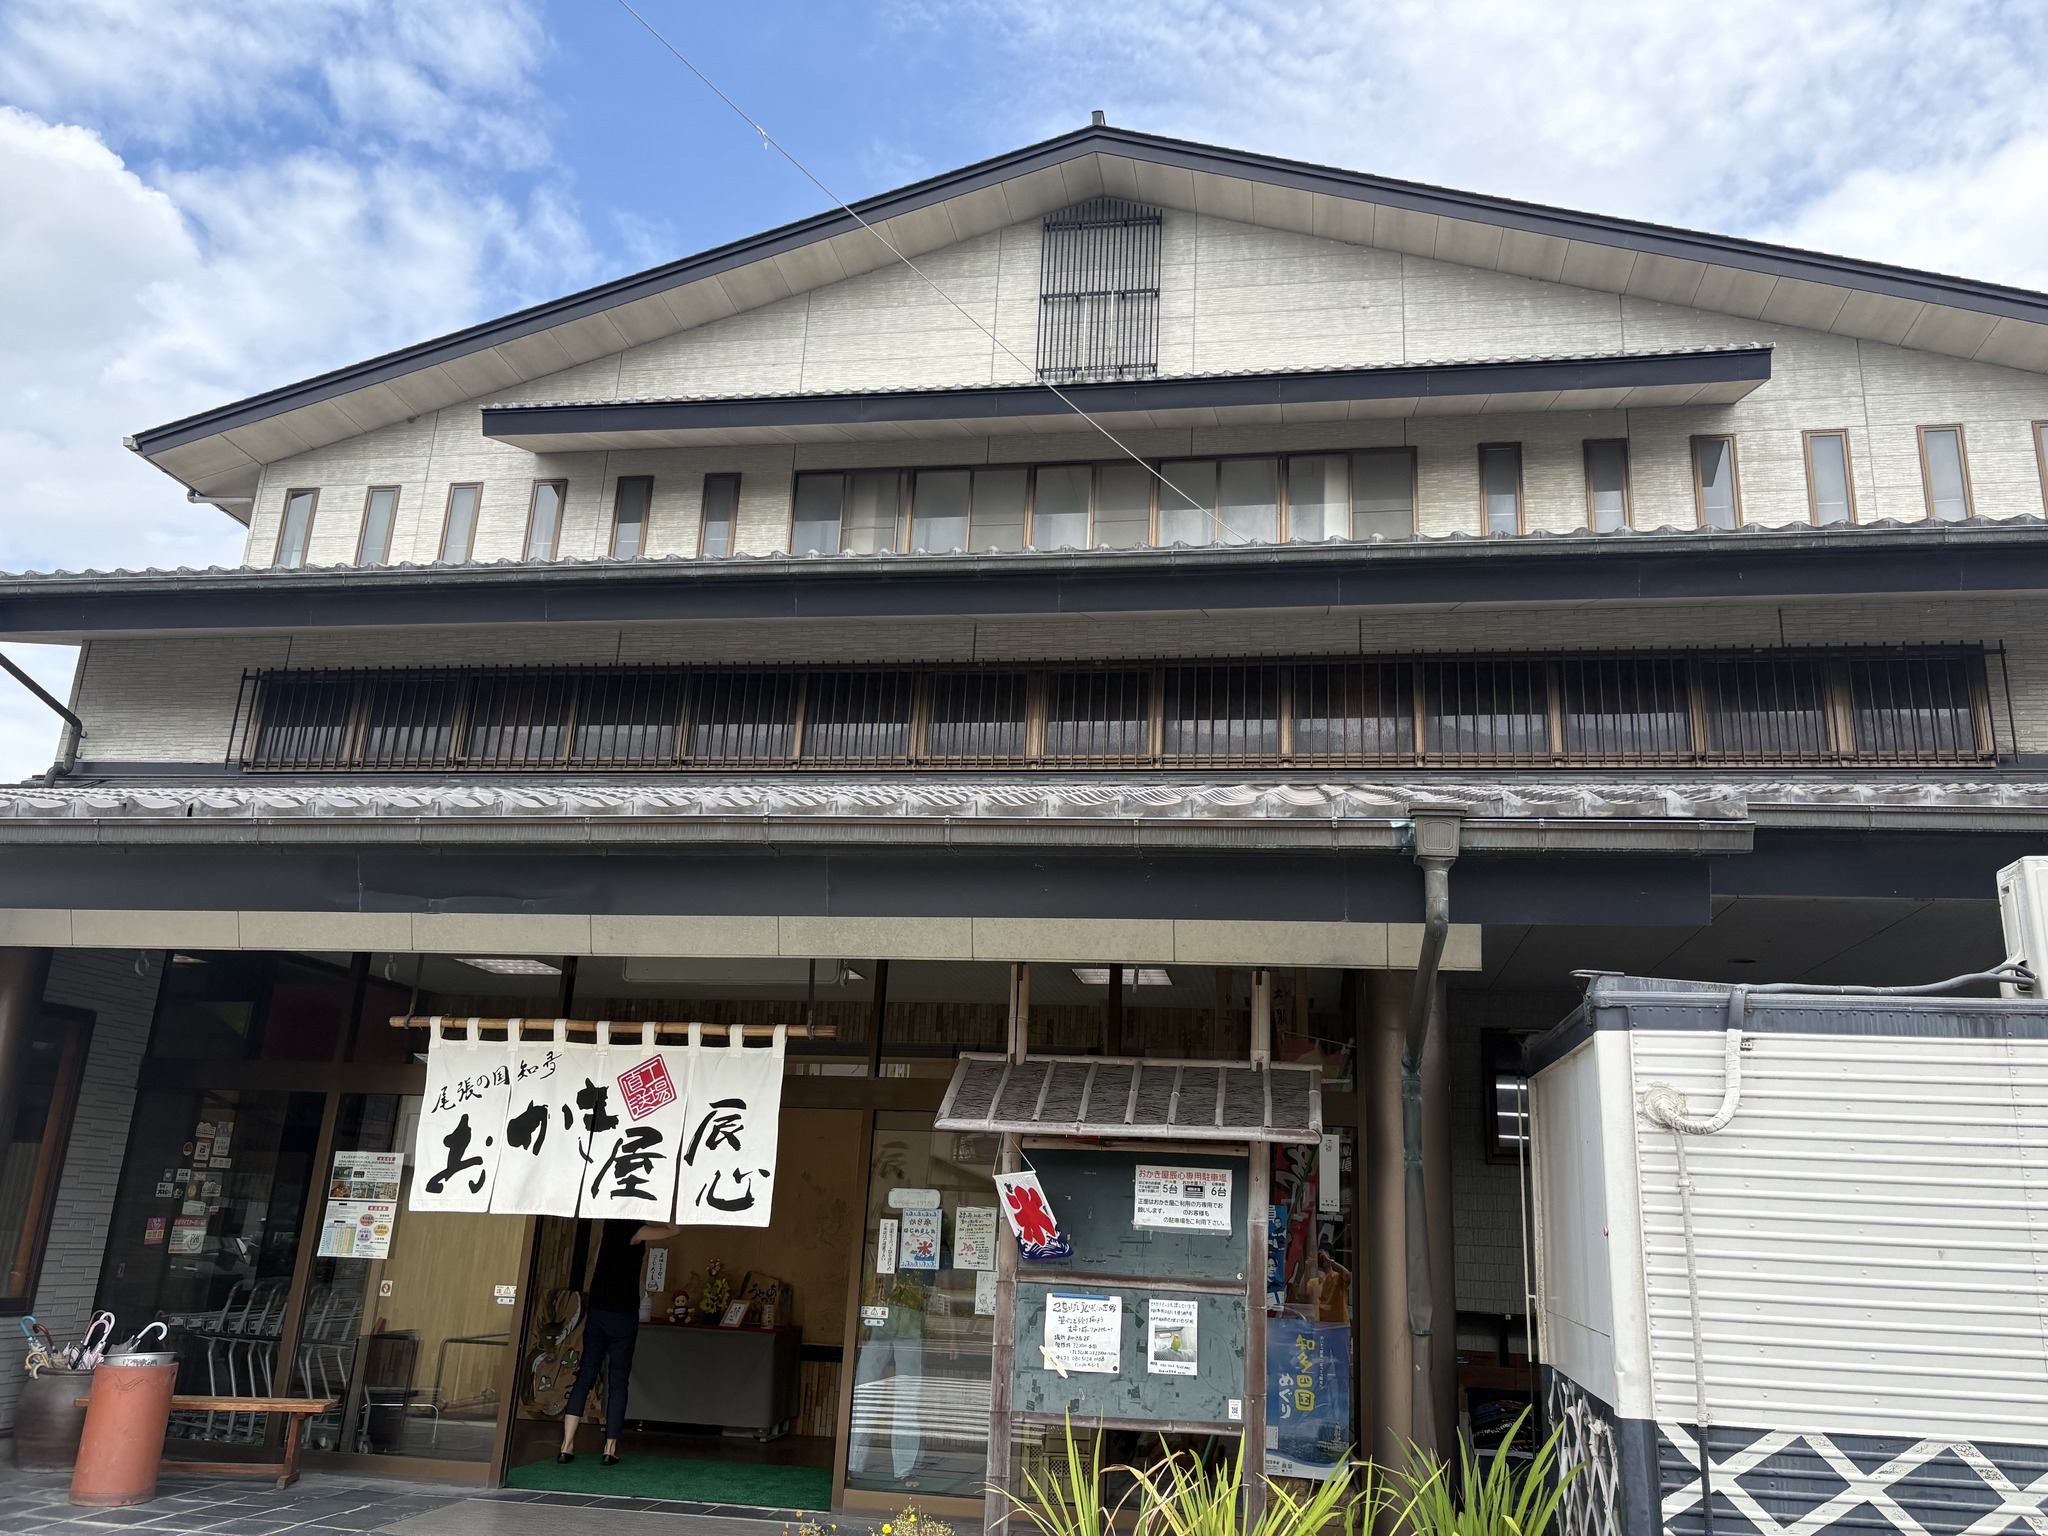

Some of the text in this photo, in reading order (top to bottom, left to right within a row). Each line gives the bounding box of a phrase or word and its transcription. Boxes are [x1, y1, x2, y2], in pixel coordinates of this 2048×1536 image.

[1138, 1169, 1227, 1183] おかき屋辰心専用駐車場
[1162, 1184, 1178, 1195] 5台
[1211, 1187, 1227, 1197] 6台
[1294, 1333, 1316, 1412] 知多四国
[1279, 1373, 1295, 1419] めぐり
